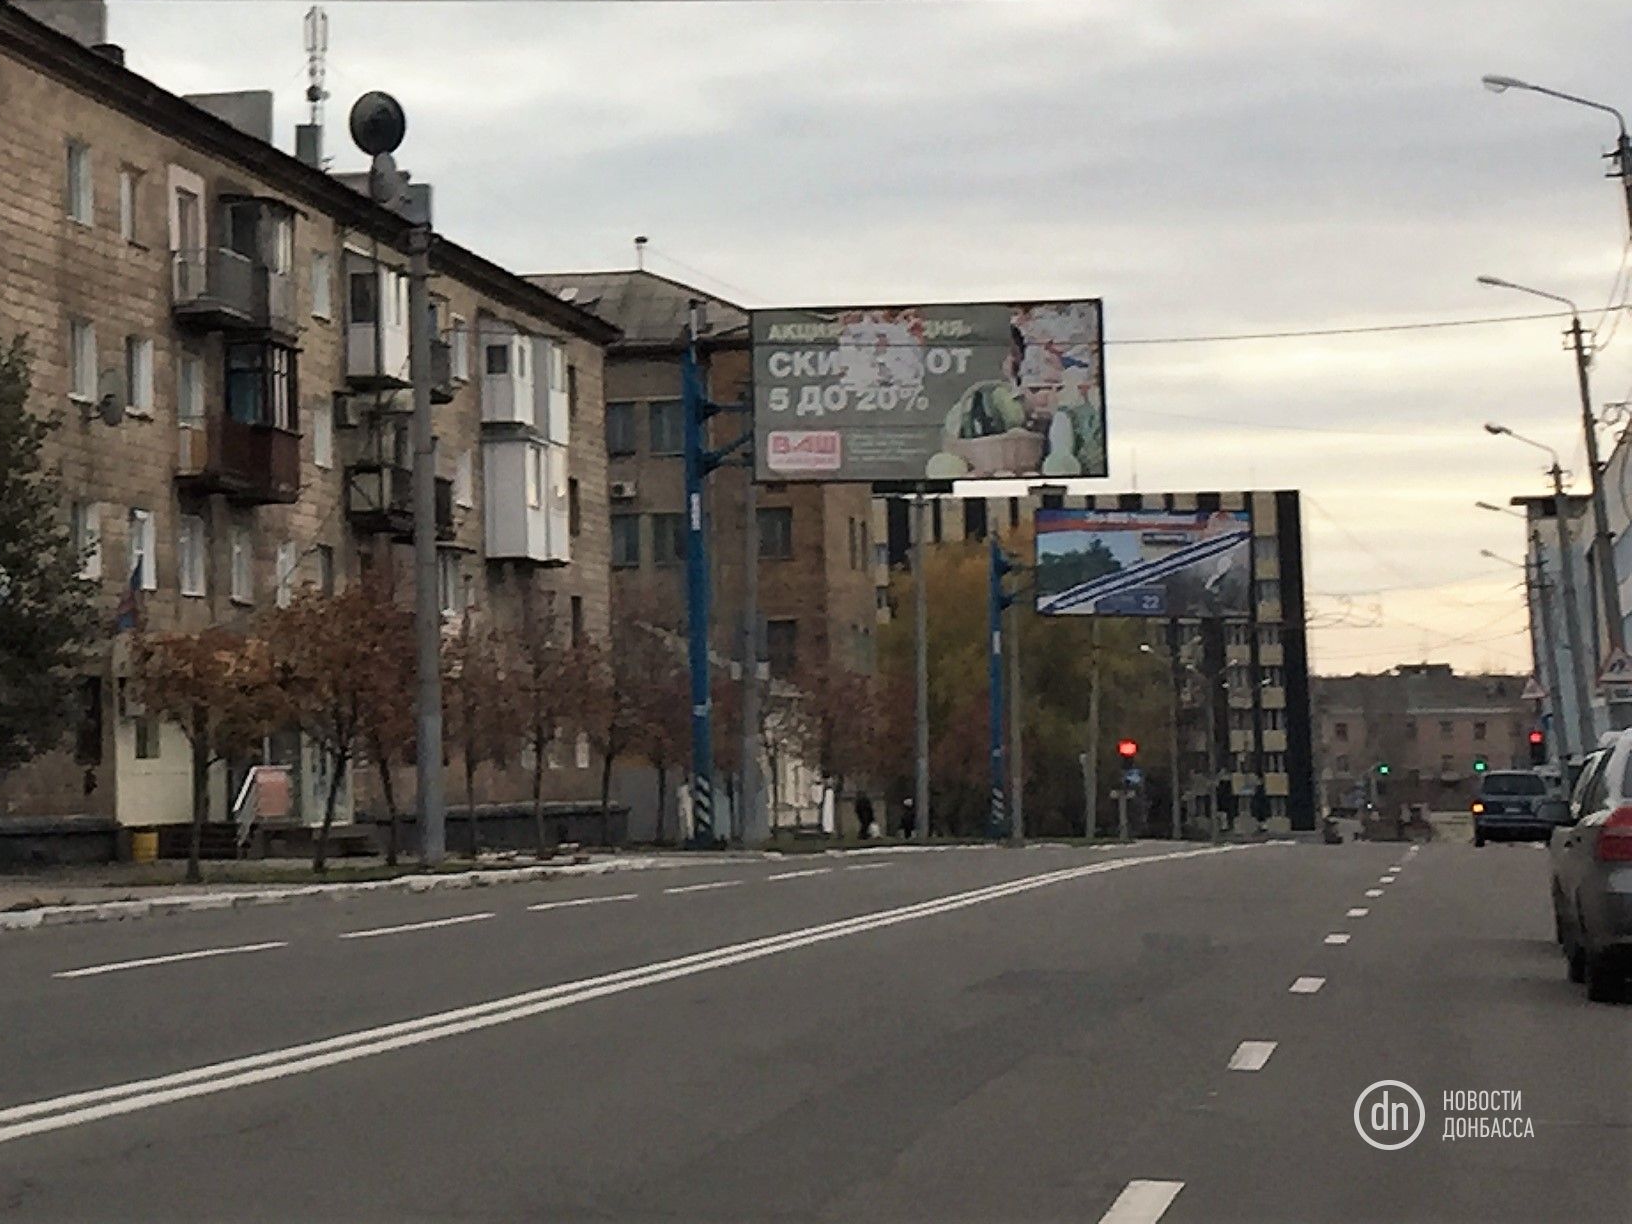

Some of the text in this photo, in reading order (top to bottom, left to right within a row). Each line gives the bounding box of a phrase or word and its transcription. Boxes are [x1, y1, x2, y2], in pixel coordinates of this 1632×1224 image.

[926, 348, 972, 374] ОТ
[769, 384, 930, 416] 5 ДО 20%
